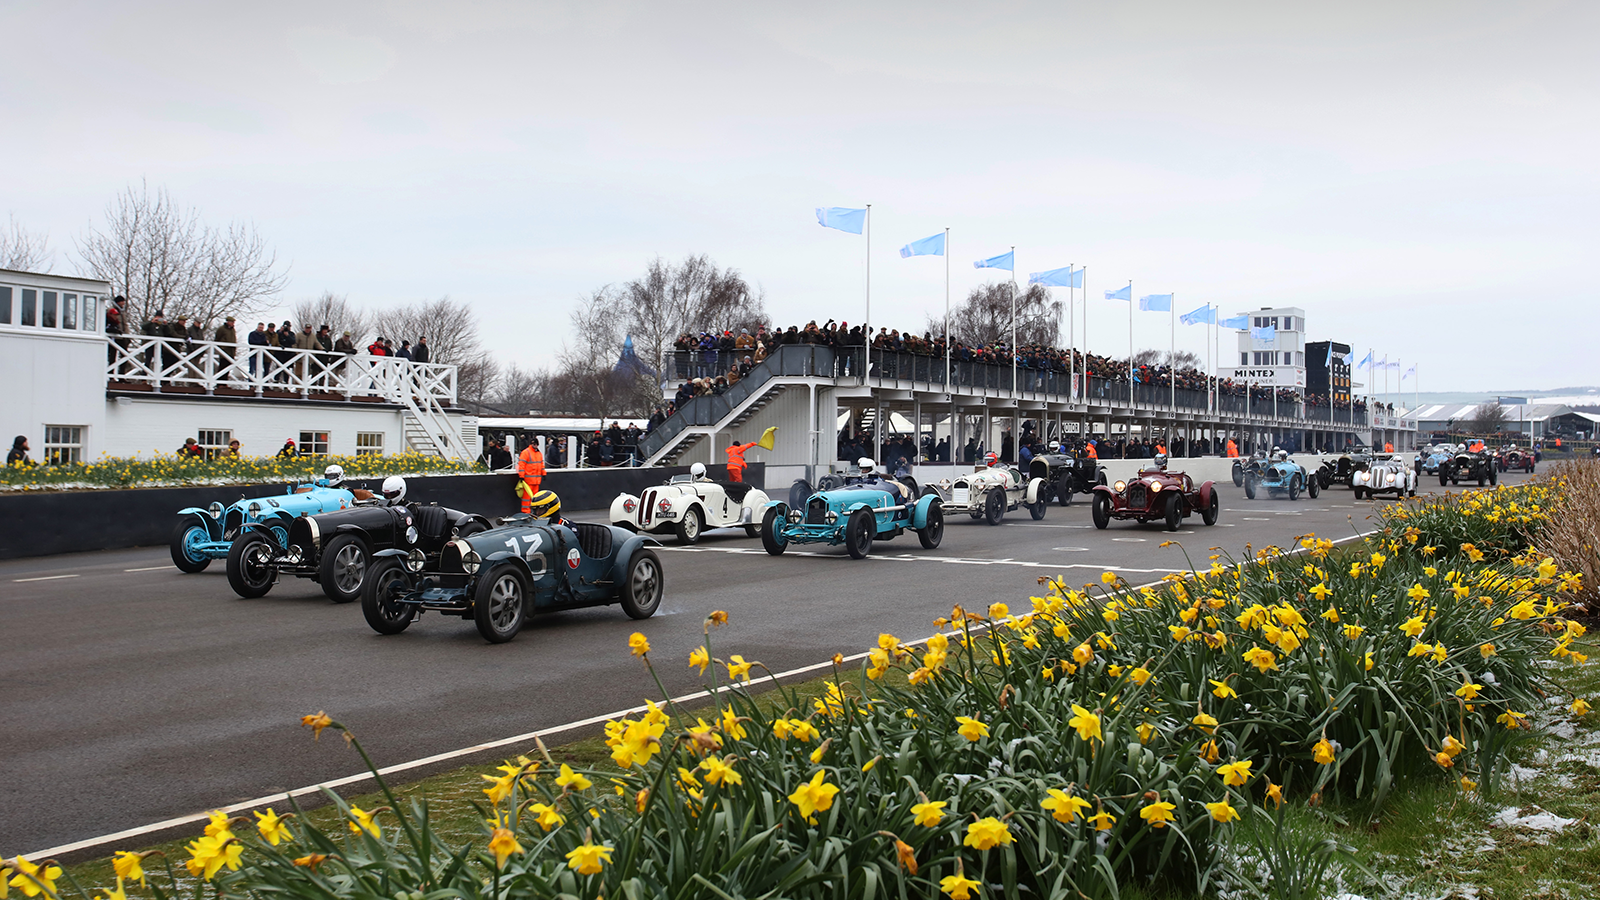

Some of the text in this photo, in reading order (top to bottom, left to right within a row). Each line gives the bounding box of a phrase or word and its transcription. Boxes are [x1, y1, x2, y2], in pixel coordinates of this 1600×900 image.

[266, 499, 280, 508] 6
[722, 497, 728, 518] 4
[504, 533, 547, 581] 13
